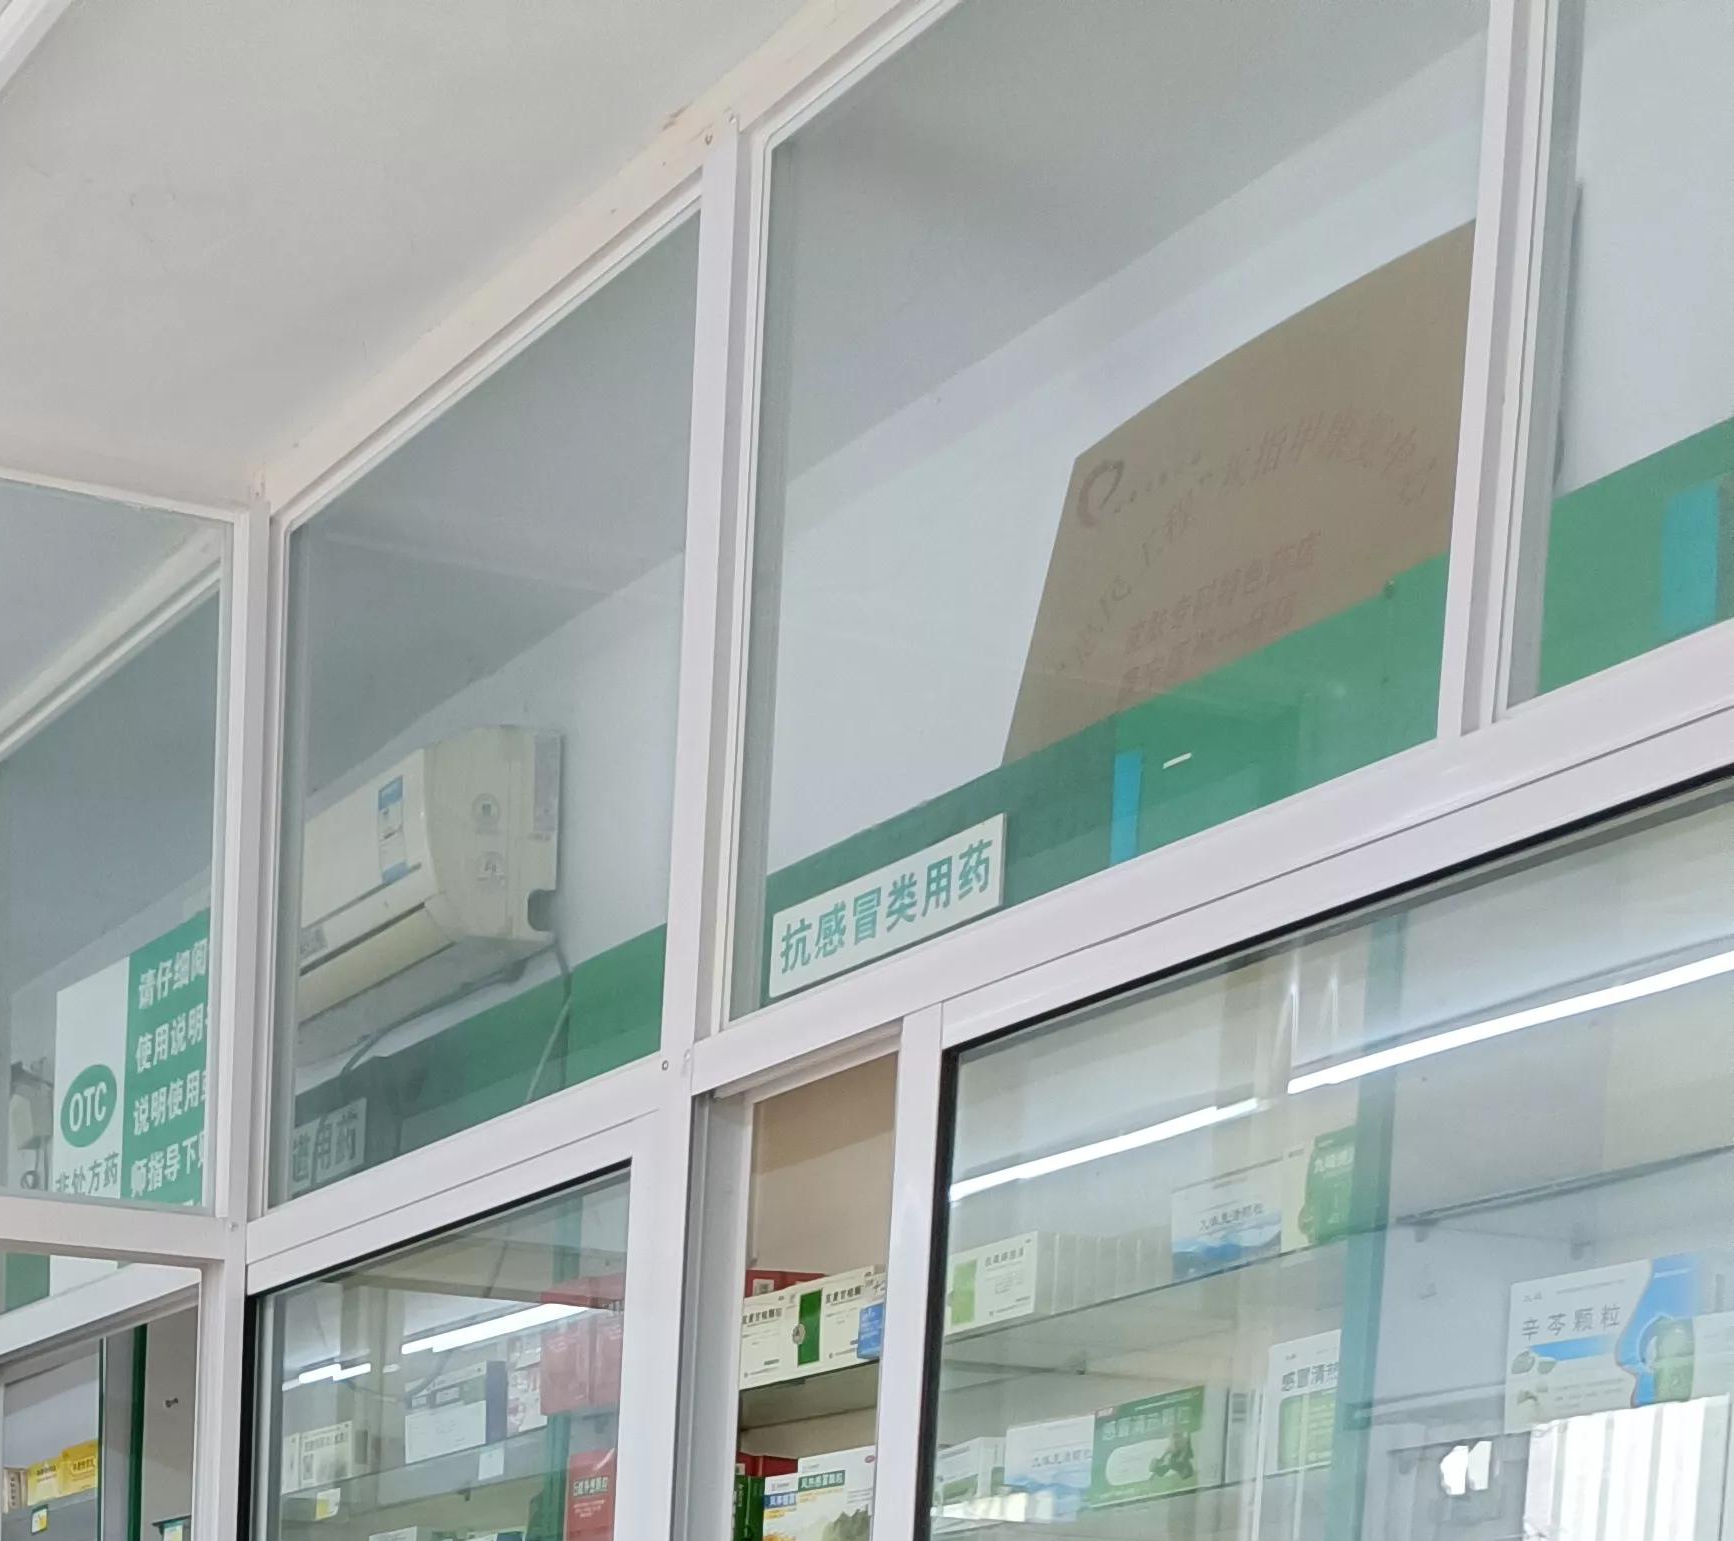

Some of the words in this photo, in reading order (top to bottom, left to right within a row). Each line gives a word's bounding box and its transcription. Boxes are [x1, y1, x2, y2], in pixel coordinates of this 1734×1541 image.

[779, 838, 993, 974] 抗感冒类用药
[135, 1003, 209, 1074] 使用说明
[69, 1081, 107, 1131] OTC
[1522, 1304, 1621, 1340] 辛芩颗粒
